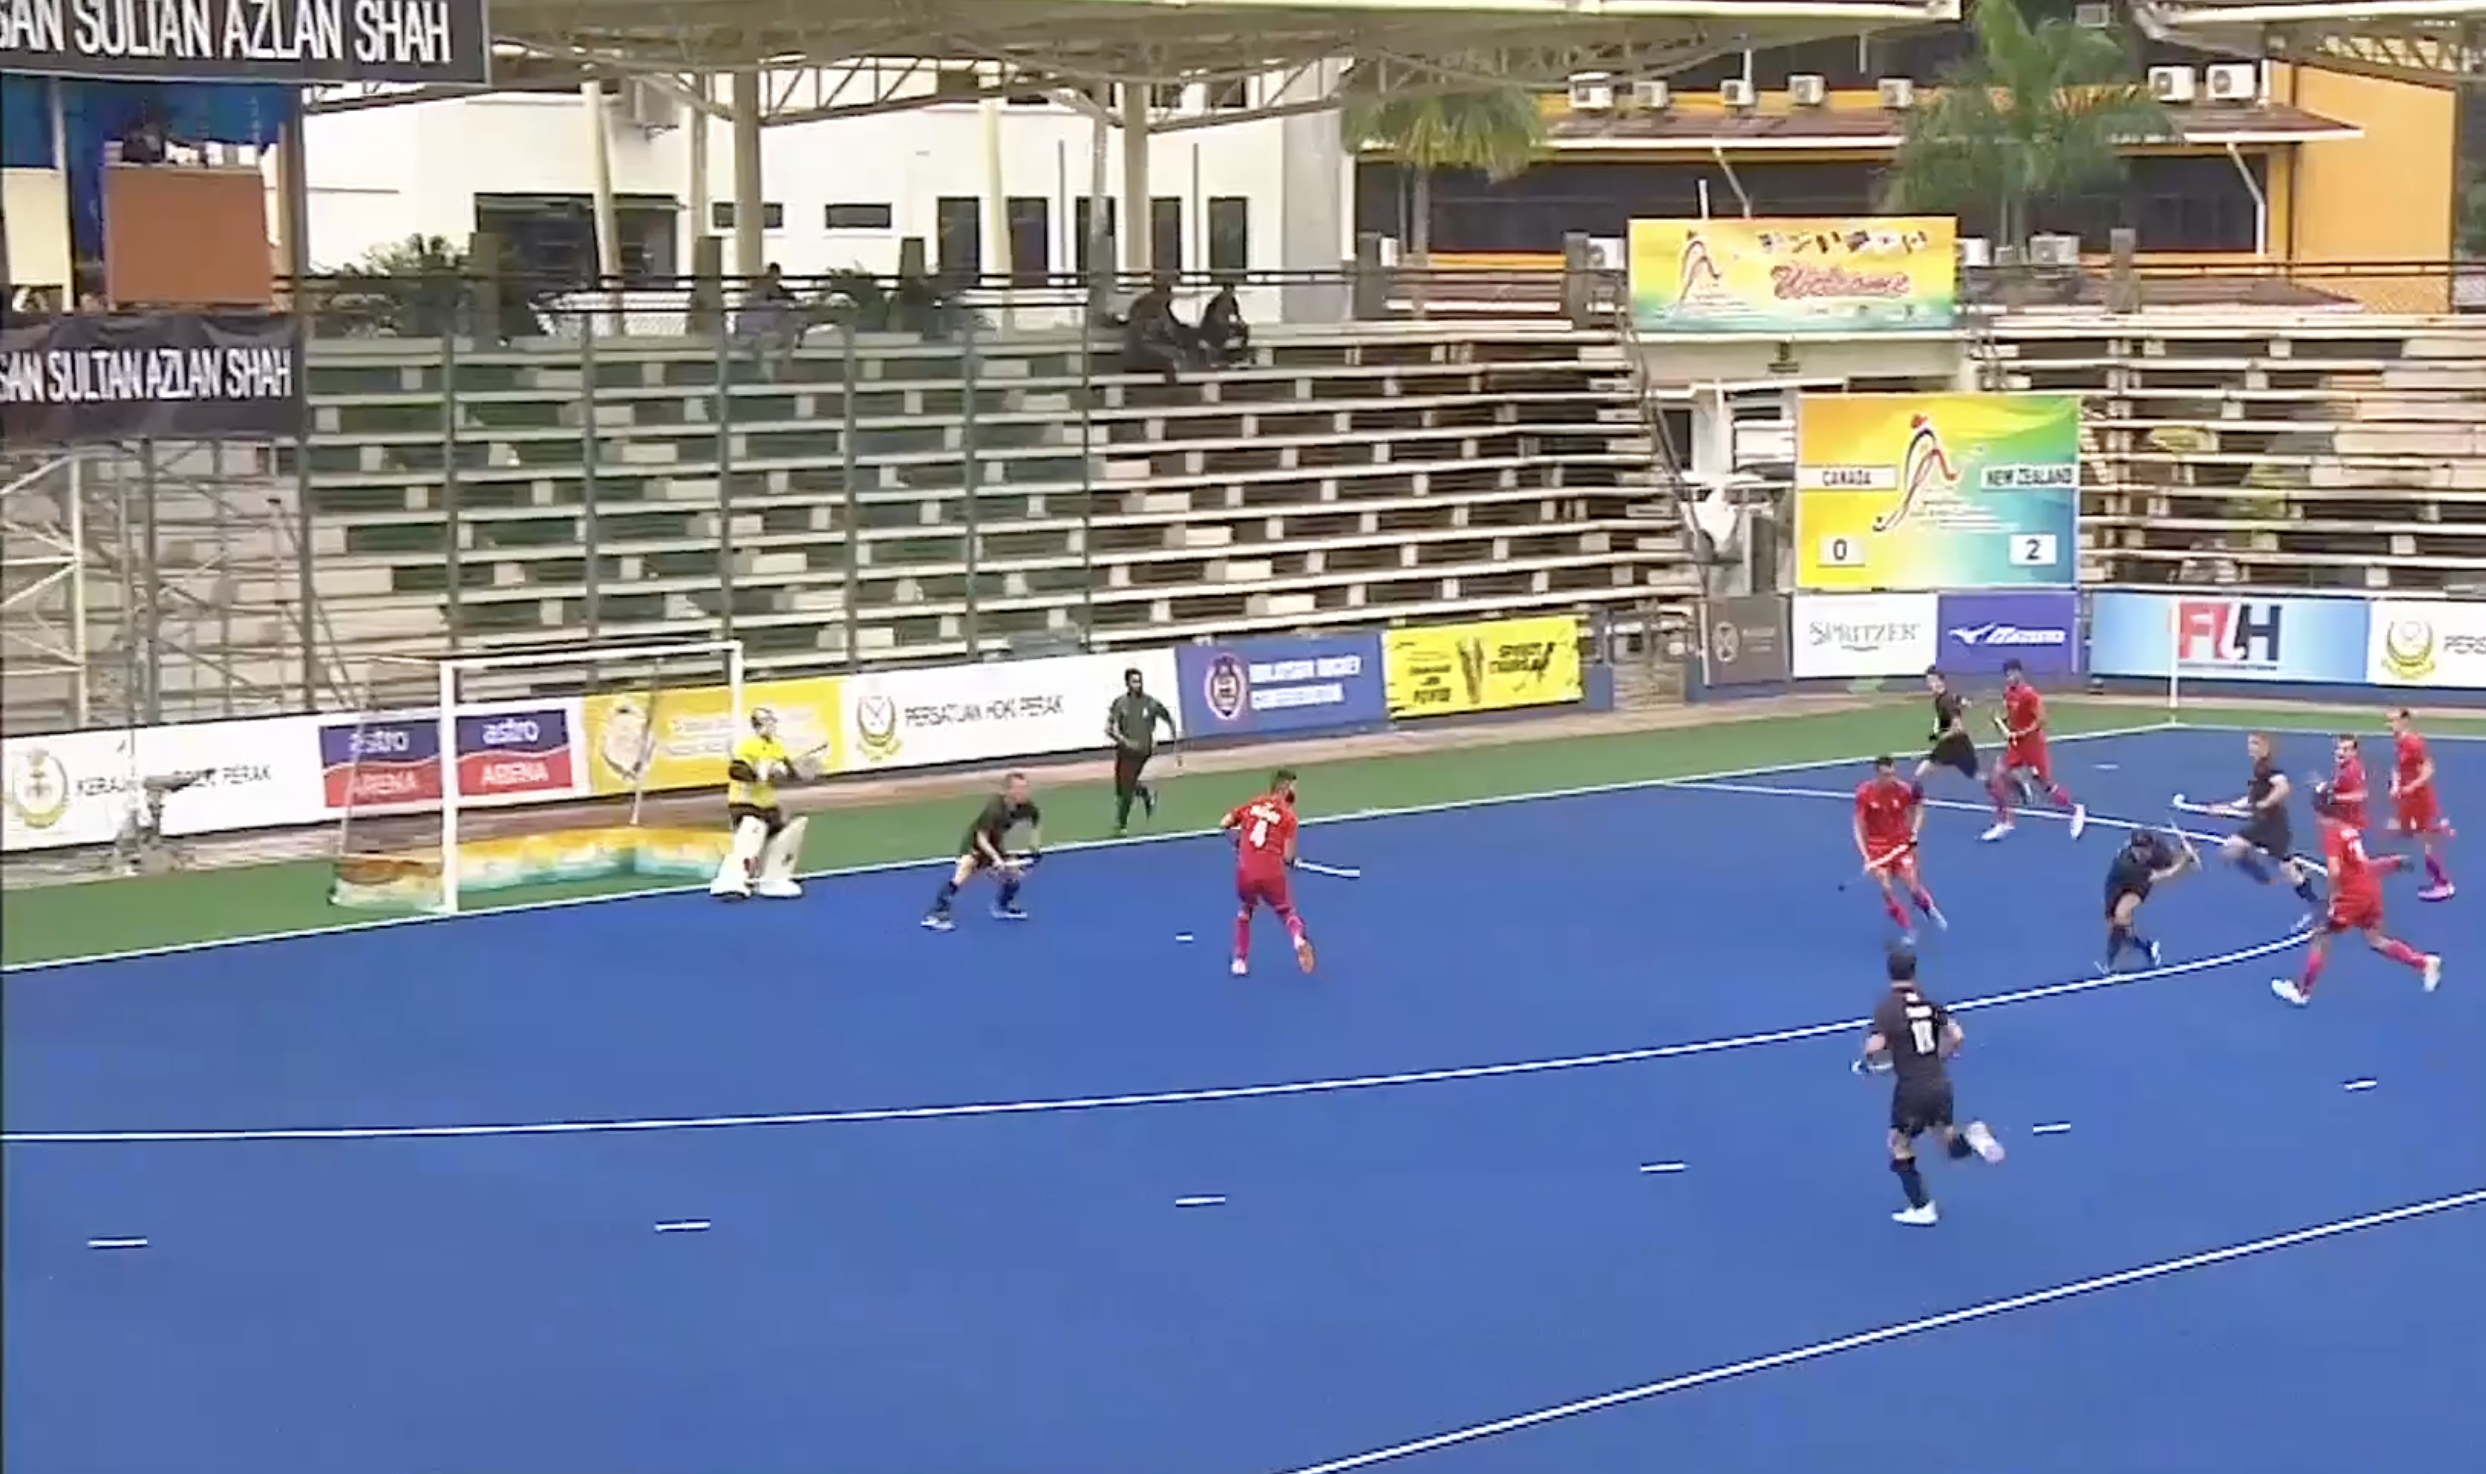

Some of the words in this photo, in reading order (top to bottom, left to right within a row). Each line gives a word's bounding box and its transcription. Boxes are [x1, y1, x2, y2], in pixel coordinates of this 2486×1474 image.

[75, 0, 213, 57] SULTAN
[223, 0, 344, 60] AZLAN
[354, 0, 453, 63] SHAH
[1770, 263, 1910, 300] Welcome
[49, 350, 142, 402] SULTAN
[146, 349, 222, 399] AZLAN
[226, 349, 292, 398] SHAH
[1822, 468, 1872, 486] CANADA
[1987, 468, 2014, 486] NEW
[2017, 466, 2073, 485] ZEALAND
[1833, 538, 1848, 561] 0
[2025, 538, 2042, 561] 2
[1809, 620, 1920, 646] SPRITZER
[905, 702, 981, 727] PERSATUAN
[1020, 694, 1064, 716] PERAK
[481, 762, 549, 788] ARENA
